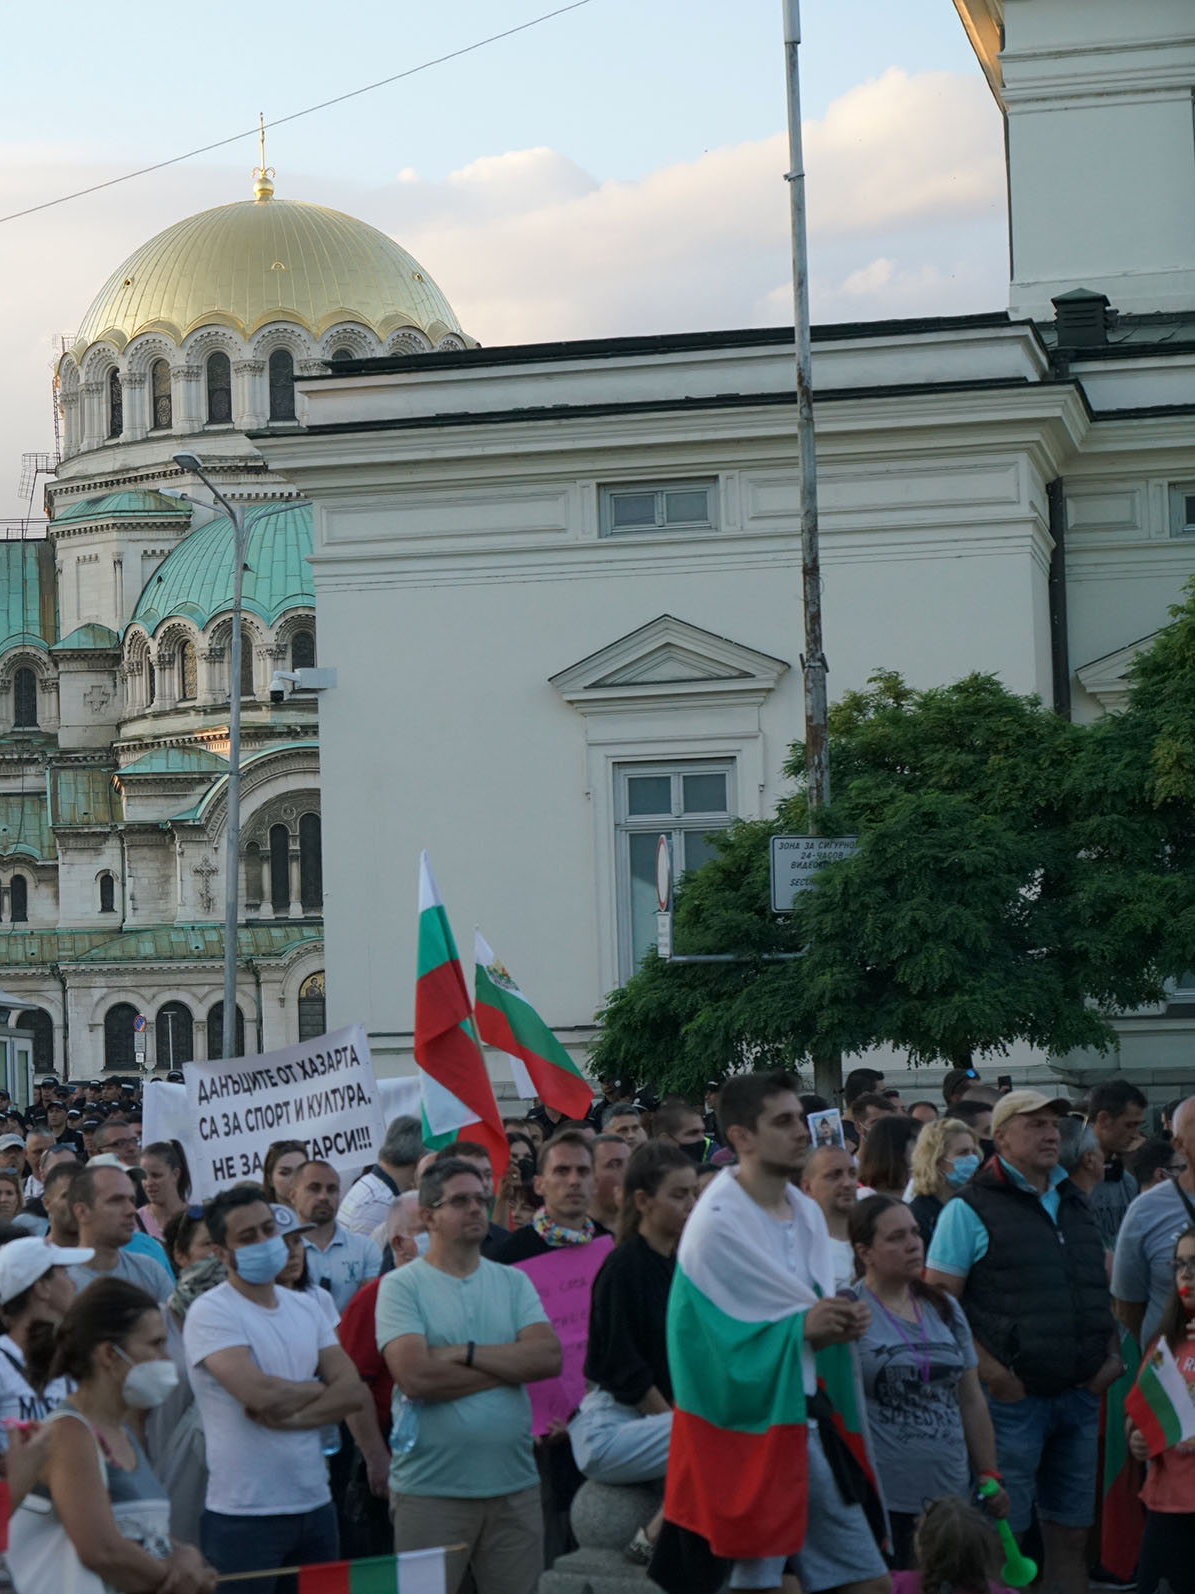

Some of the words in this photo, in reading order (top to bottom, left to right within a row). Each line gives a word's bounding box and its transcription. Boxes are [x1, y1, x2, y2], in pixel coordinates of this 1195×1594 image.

[778, 842, 800, 850] ЗОНА
[805, 842, 814, 850] ЗА
[818, 841, 855, 850] СИГУРНО
[198, 1068, 279, 1106] ДАНЪЦИТЕ
[276, 1063, 298, 1085] ОТ
[296, 1044, 361, 1081] ХАЗАРТА
[199, 1115, 220, 1141] СА
[222, 1111, 243, 1137] ЗА
[245, 1100, 291, 1133] СПОРТ
[294, 1098, 305, 1123] И
[307, 1082, 372, 1120] КУЛТУРА.
[212, 1155, 237, 1182] НЕ
[239, 1151, 264, 1177] ЗА
[304, 1125, 373, 1161] АРСИ!!!
